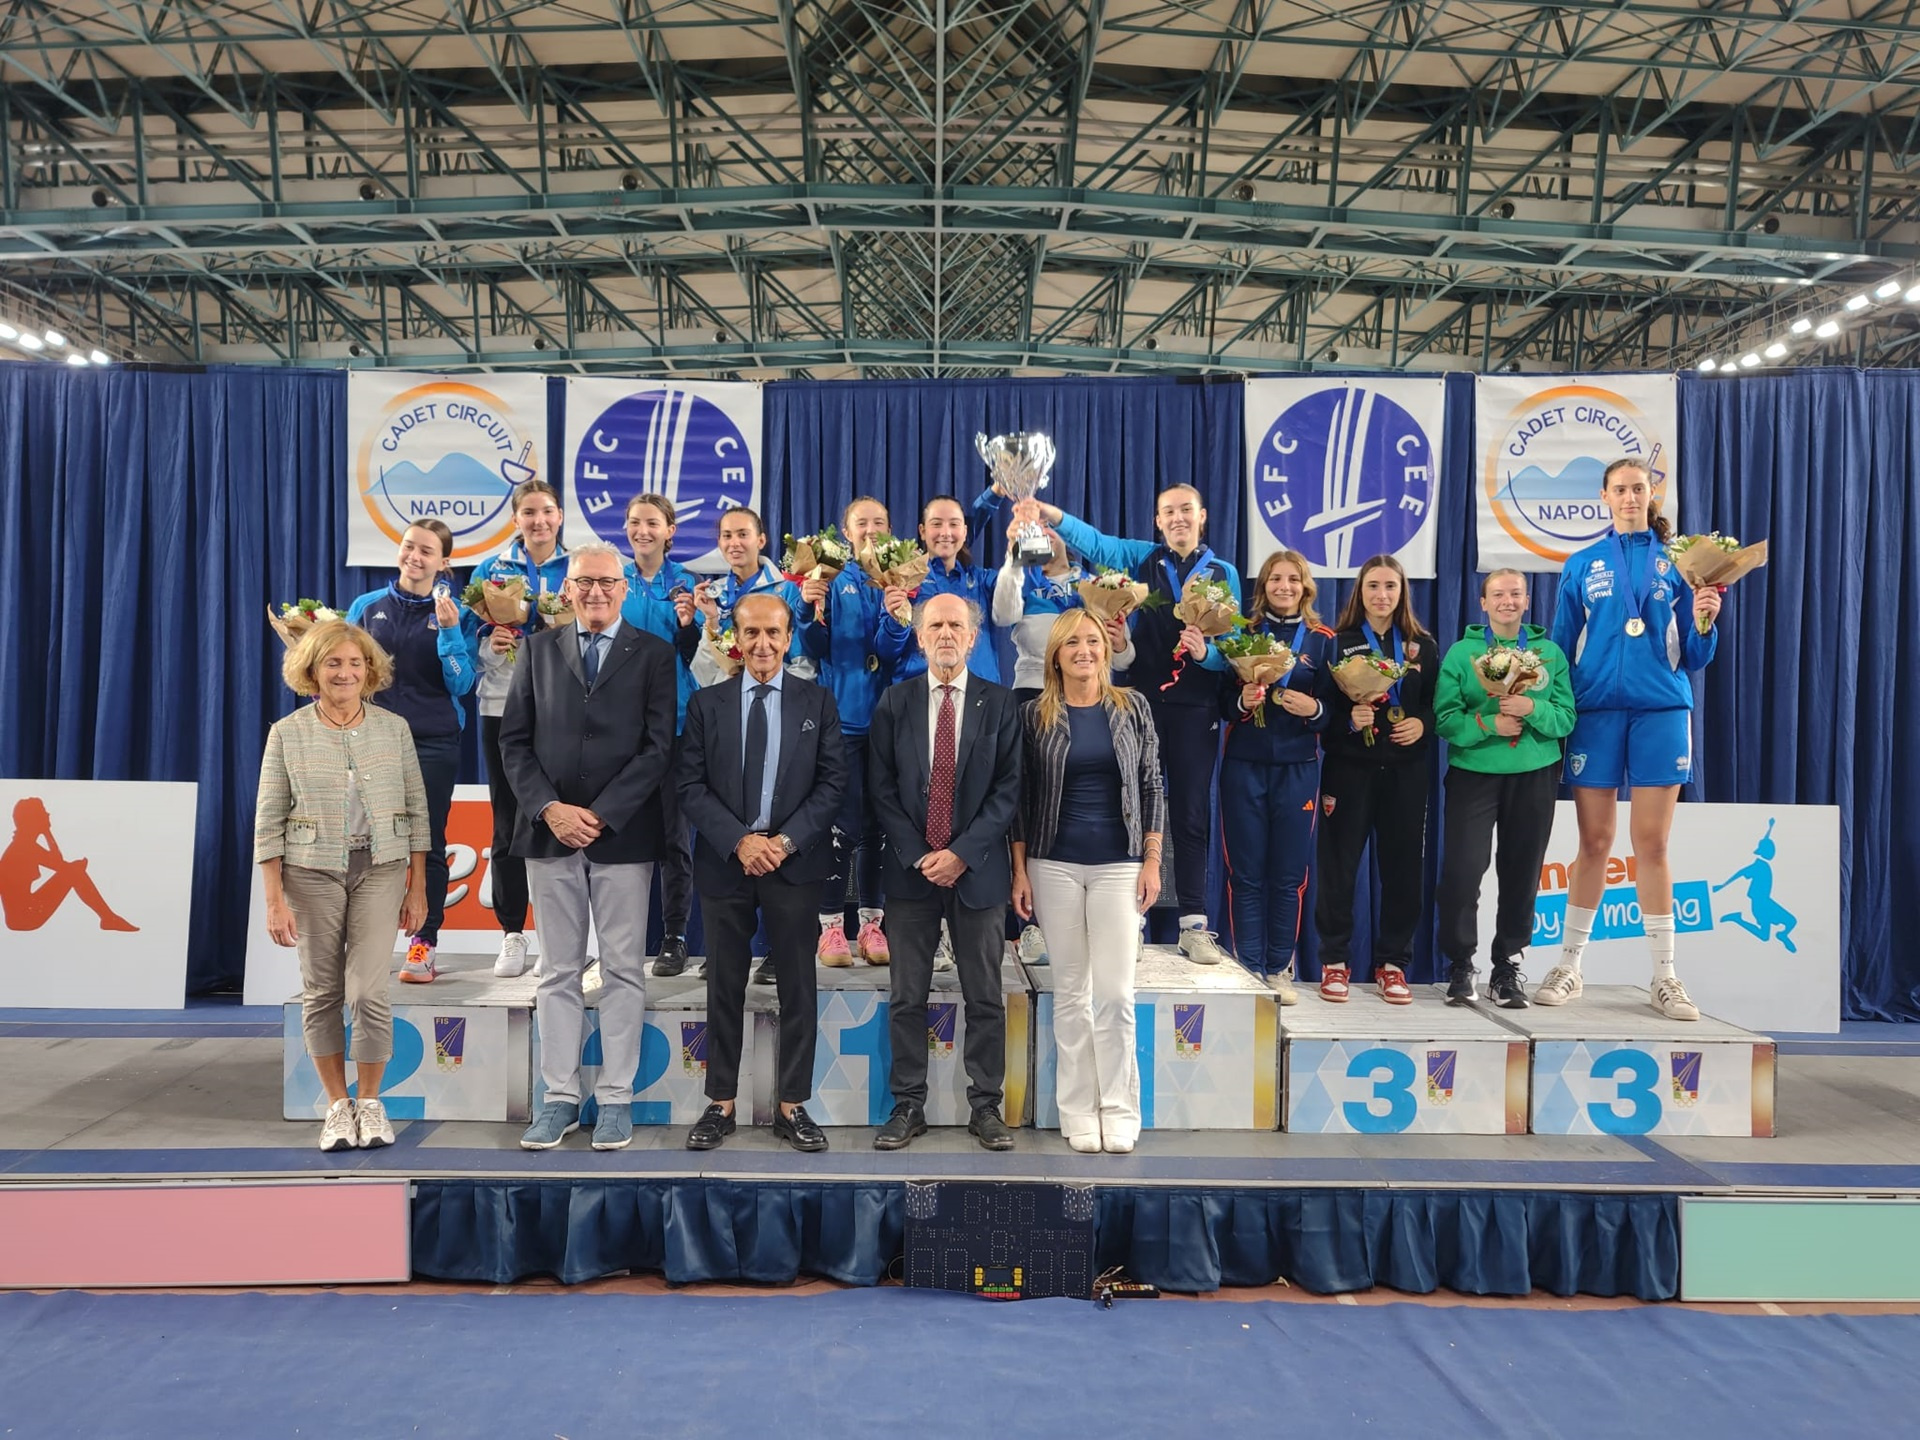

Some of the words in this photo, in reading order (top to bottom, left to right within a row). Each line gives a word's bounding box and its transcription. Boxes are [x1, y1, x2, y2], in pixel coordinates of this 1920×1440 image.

[382, 404, 437, 452] CADET
[446, 403, 513, 454] CIRCUIT
[1509, 407, 1566, 457] CADET
[1575, 406, 1642, 456] CIRCUIT
[583, 429, 619, 514] EFC
[1263, 431, 1298, 517] EFC
[1396, 434, 1428, 516] CEE
[410, 499, 486, 517] NAPOLI
[1603, 897, 1701, 926] mong
[927, 1003, 941, 1011] FIS
[1175, 1004, 1189, 1012] FIS
[435, 1017, 450, 1025] FIS
[682, 1022, 696, 1030] FIS
[1428, 1051, 1441, 1059] FIS
[1672, 1052, 1686, 1060] FIS
[1343, 1048, 1417, 1133] 3
[1587, 1048, 1662, 1135] 3
